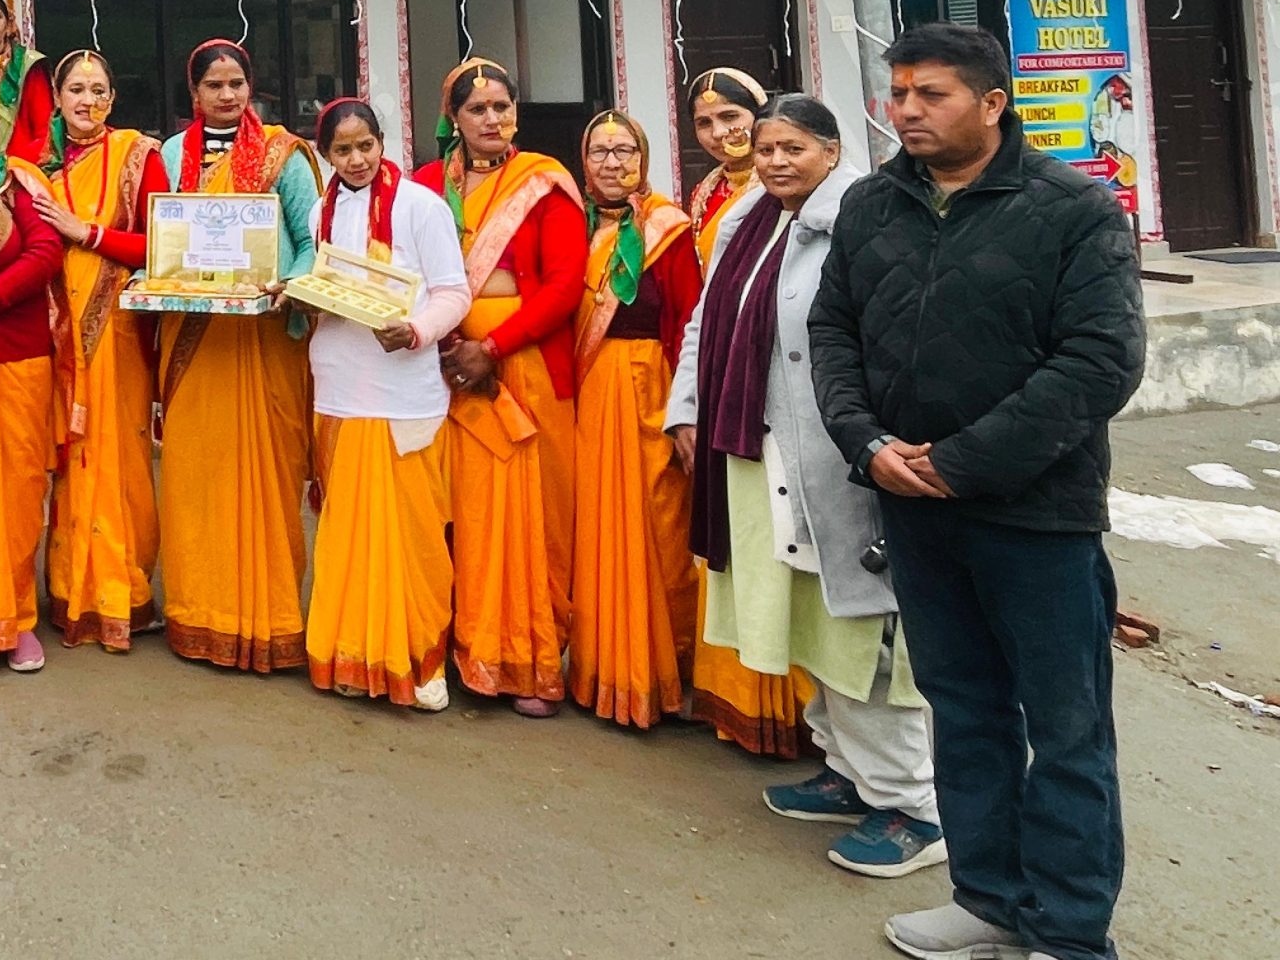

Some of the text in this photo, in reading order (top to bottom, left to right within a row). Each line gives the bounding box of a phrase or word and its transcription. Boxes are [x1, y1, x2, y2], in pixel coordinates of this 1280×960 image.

[1037, 26, 1111, 51] HOTEL
[1019, 58, 1038, 69] FOR
[1018, 79, 1080, 95] BREAKFAST
